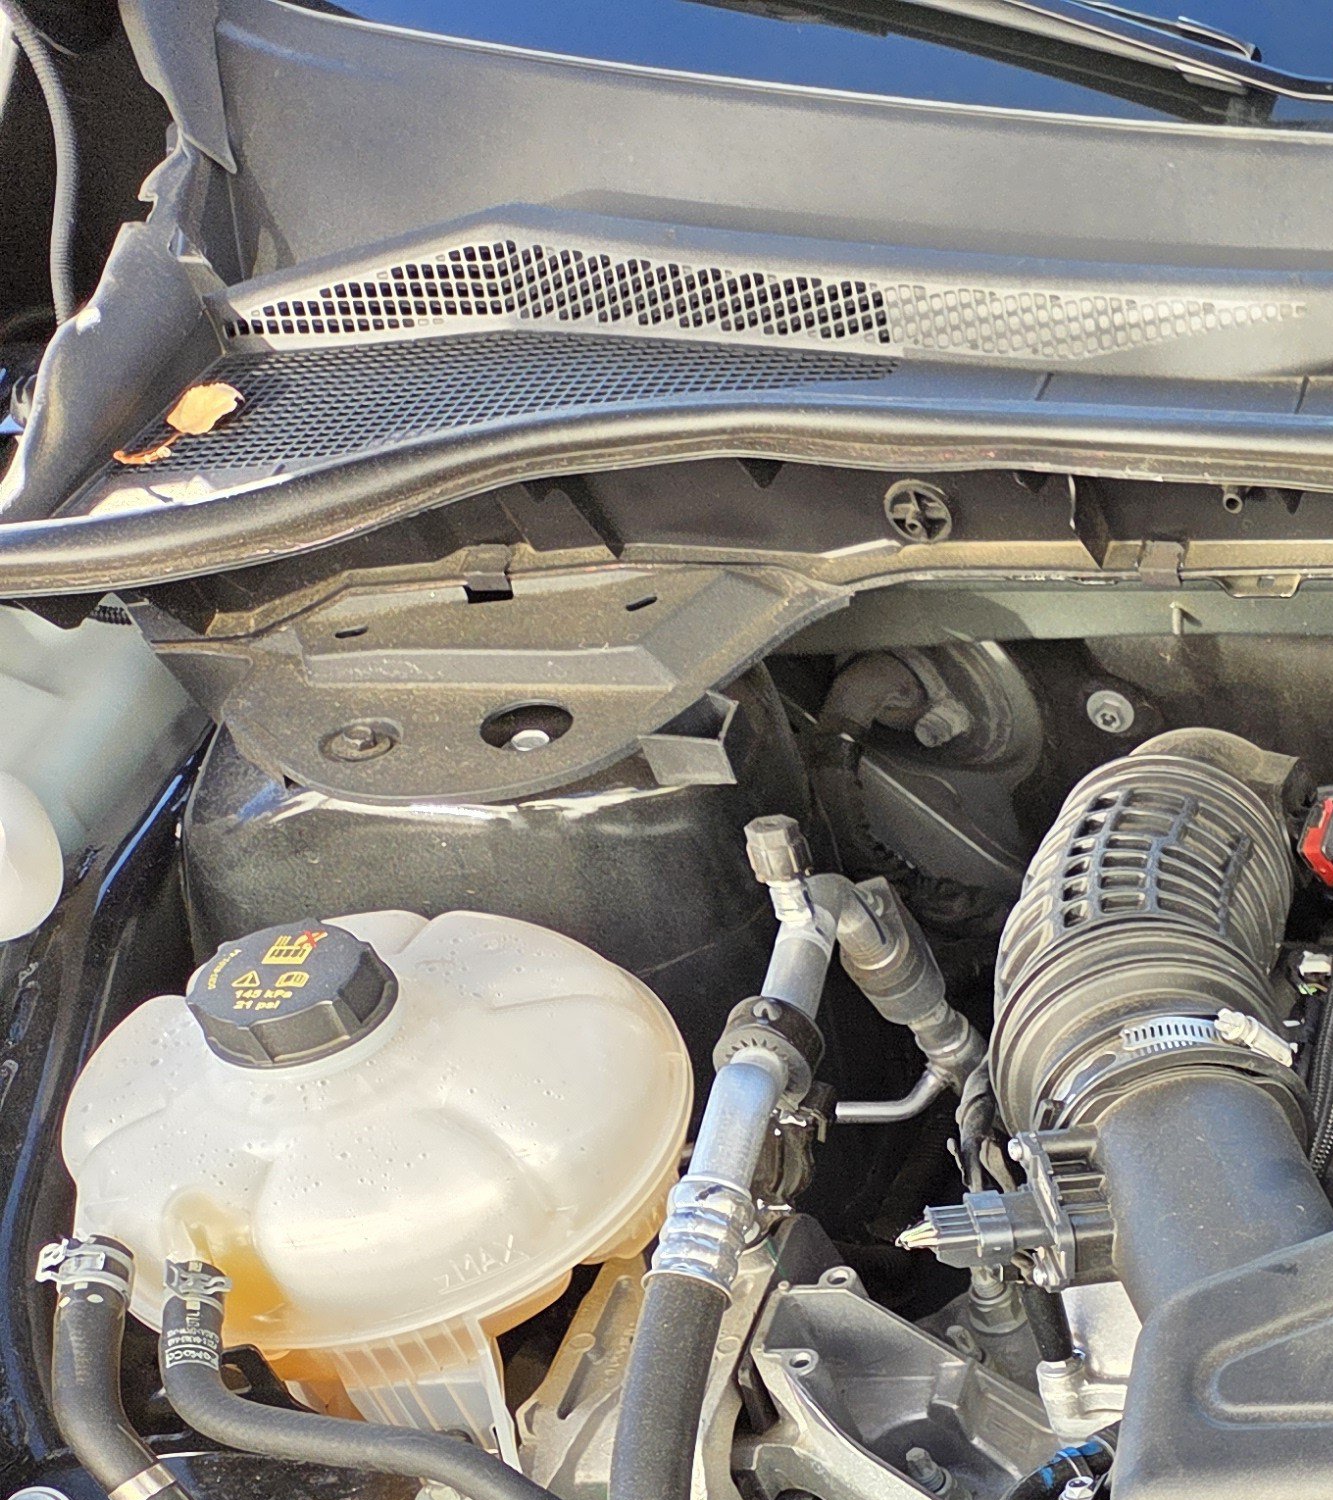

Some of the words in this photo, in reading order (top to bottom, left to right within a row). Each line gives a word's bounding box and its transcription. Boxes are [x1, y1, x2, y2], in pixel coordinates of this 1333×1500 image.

[265, 989, 293, 999] kPa
[233, 1000, 252, 1010] 21
[254, 1000, 281, 1011] psi
